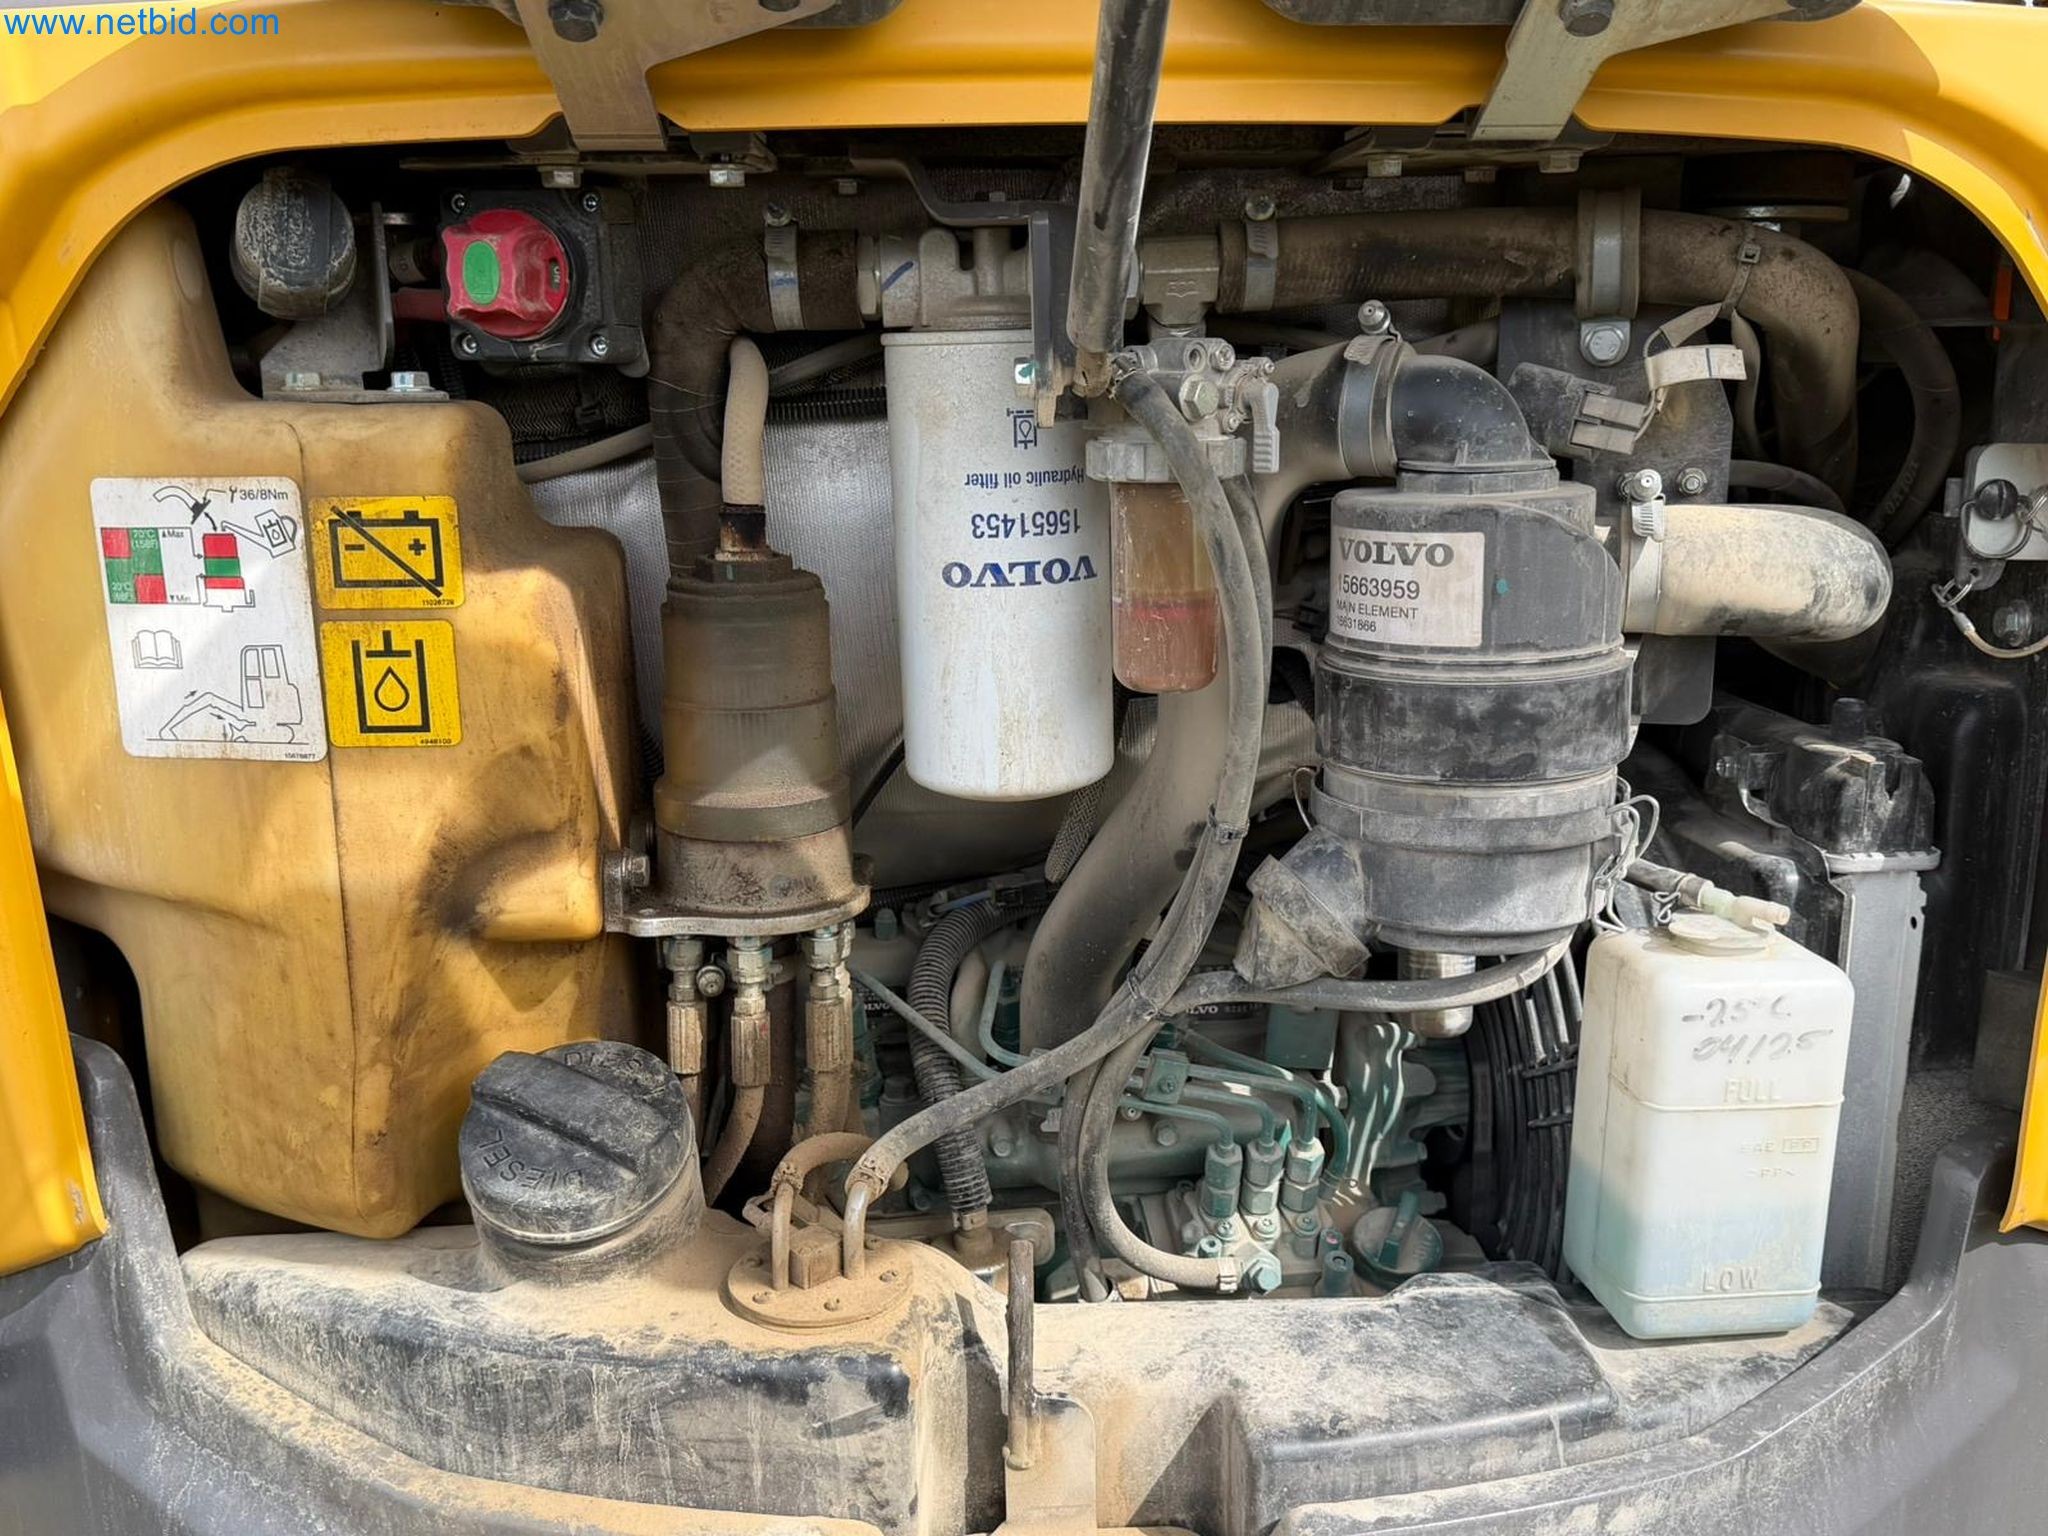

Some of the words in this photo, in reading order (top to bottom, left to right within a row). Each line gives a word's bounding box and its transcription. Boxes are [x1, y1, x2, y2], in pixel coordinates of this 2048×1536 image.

[964, 472, 999, 489] filter
[1003, 471, 1022, 489] oil
[1026, 464, 1085, 488] Hydraulic
[239, 488, 289, 501] 36/8Nm
[971, 507, 1081, 539] 15651453
[1338, 537, 1455, 567] VOLVO
[941, 555, 1098, 588] VOLVO
[1338, 574, 1420, 600] 15663959
[1358, 602, 1419, 620] ELEMENT
[1723, 1078, 1783, 1102] FULL
[479, 1129, 584, 1190] DIESEL
[1702, 1267, 1760, 1291] LOW
